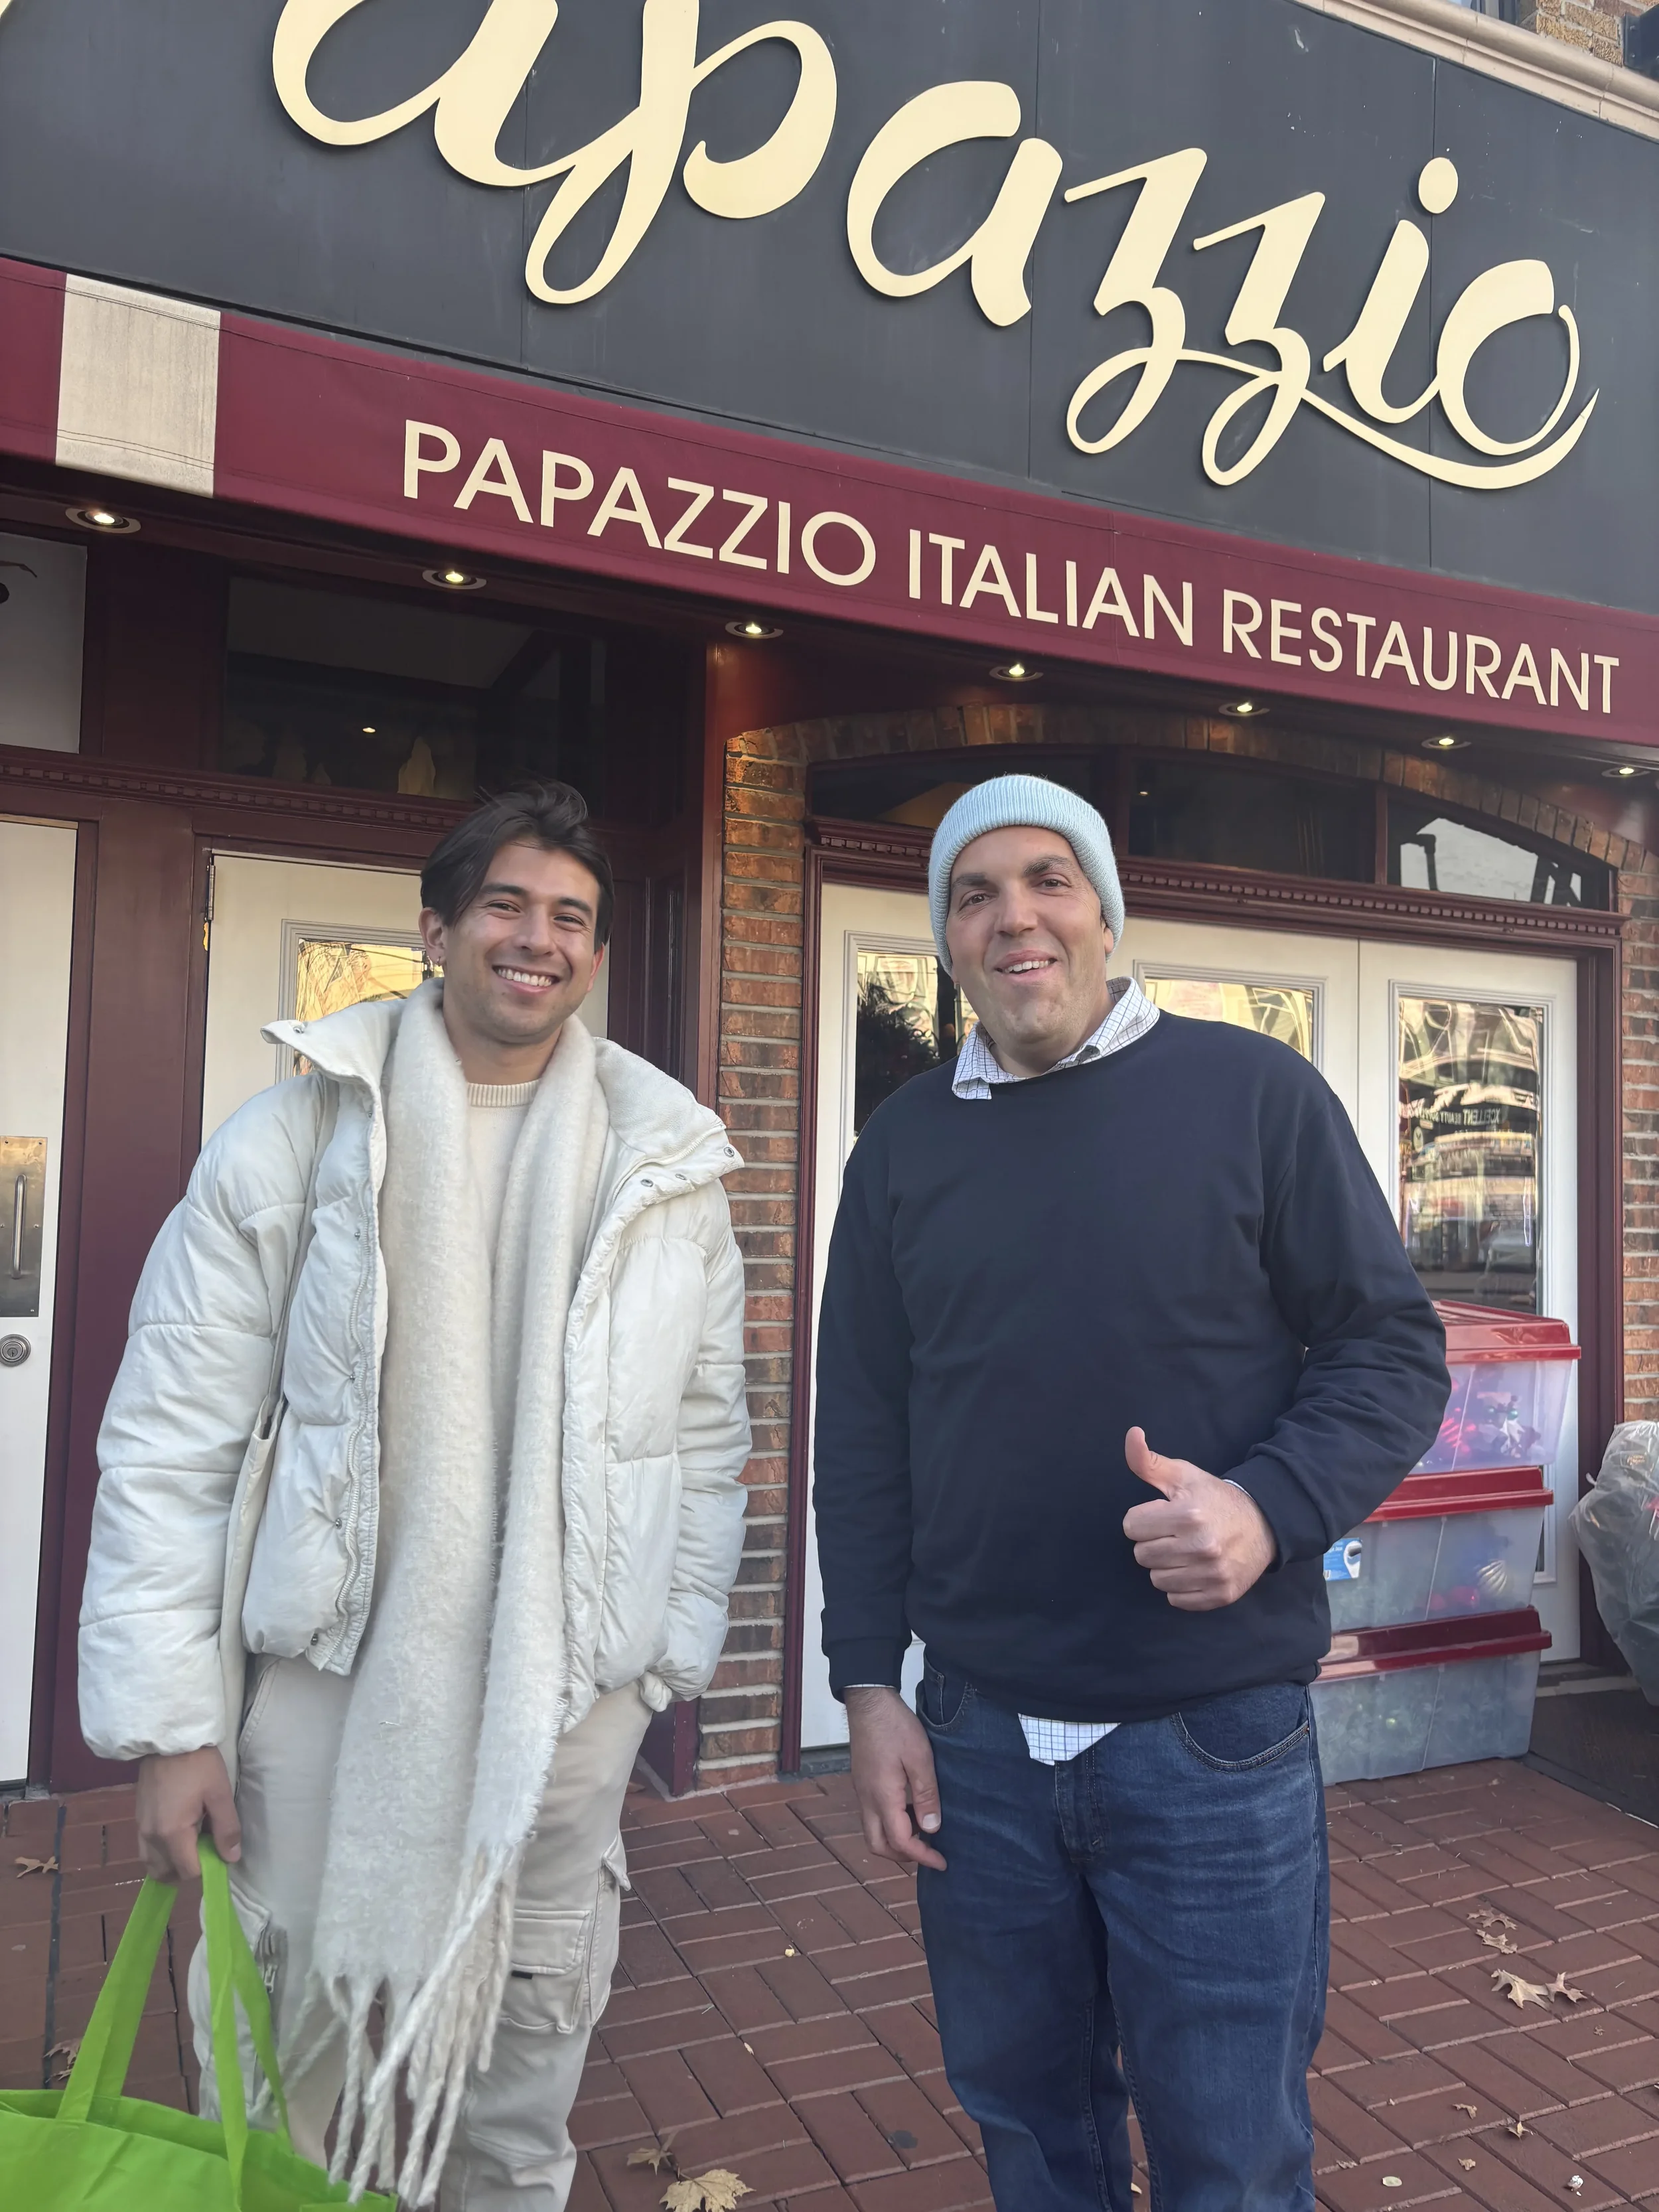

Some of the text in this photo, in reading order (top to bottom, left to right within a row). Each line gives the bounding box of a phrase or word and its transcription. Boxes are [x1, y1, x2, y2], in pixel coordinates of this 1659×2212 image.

[0, 0, 1599, 489] apazzio
[403, 419, 1620, 715] PAPAZZIO ITALIAN RESTAURANT
